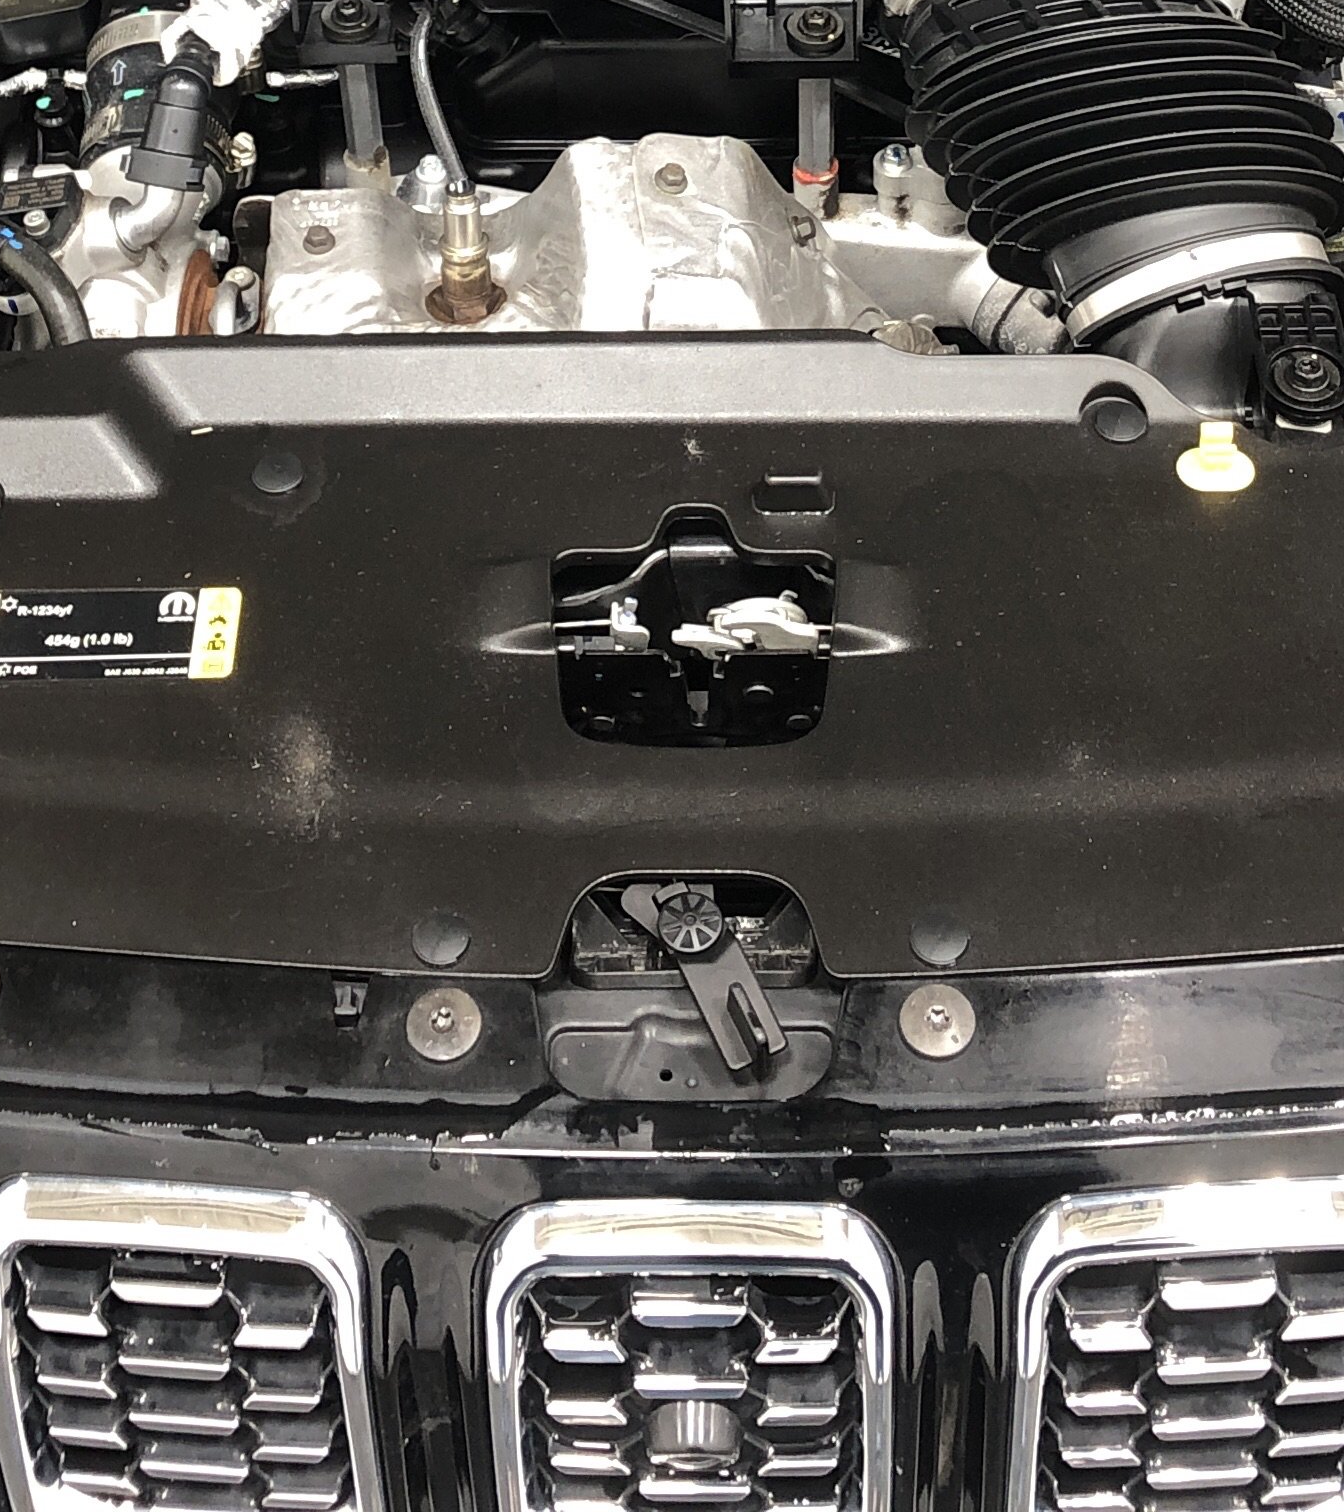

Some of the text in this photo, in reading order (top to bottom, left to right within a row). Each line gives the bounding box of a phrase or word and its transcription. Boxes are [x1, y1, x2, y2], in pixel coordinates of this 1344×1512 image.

[17, 604, 74, 618] R-1234yf
[83, 633, 110, 648] (1.0
[113, 632, 134, 647] lb)
[13, 665, 38, 675] POE
